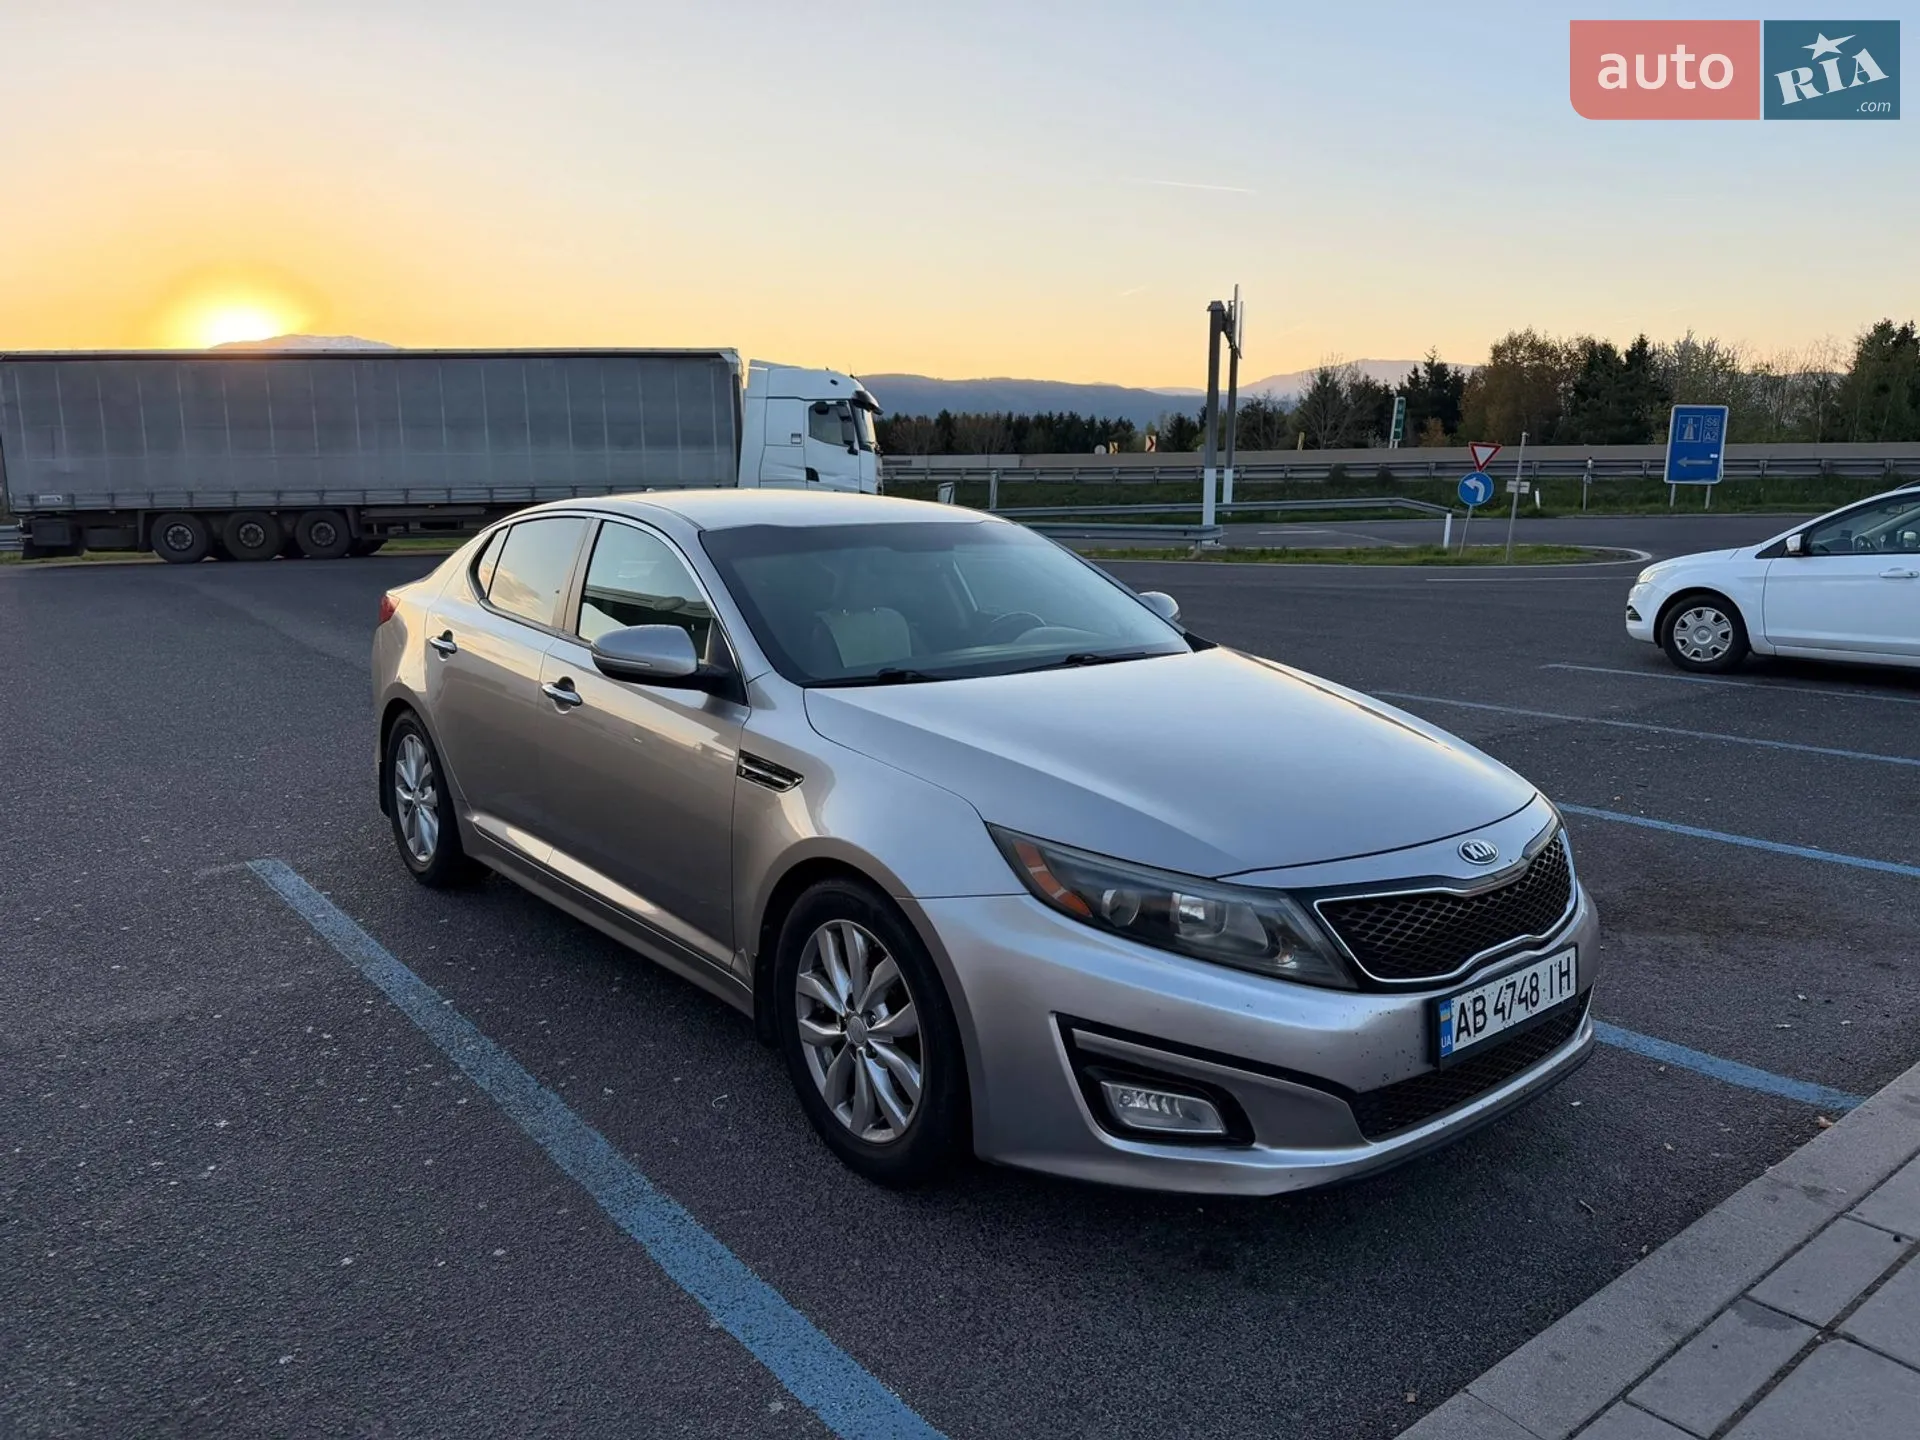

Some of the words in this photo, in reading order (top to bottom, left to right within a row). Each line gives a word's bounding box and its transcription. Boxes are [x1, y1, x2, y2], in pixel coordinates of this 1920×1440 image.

[1464, 842, 1496, 860] KIA
[1455, 995, 1487, 1042] AB
[1493, 972, 1539, 1021] 4748
[1549, 956, 1571, 999] IH
[1441, 1035, 1452, 1048] UA
